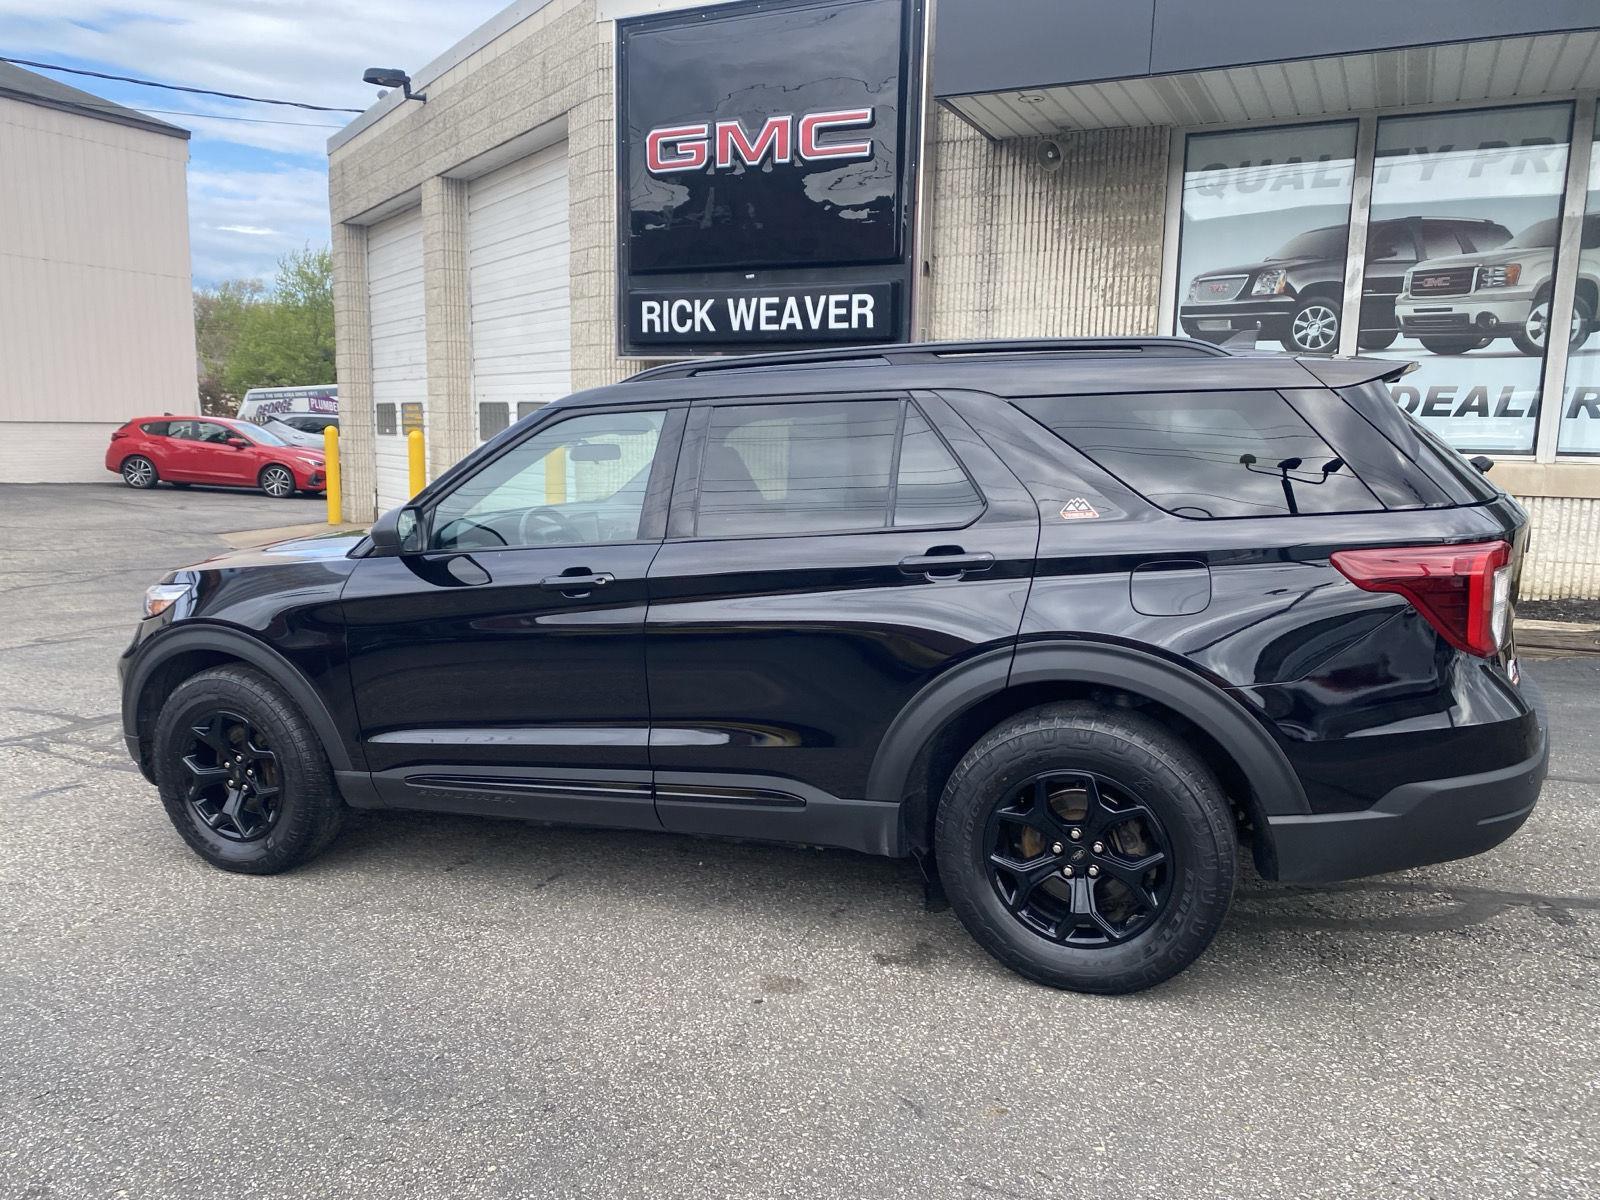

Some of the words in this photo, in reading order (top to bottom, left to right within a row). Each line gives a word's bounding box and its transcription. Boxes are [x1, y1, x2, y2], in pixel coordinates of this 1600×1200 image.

[645, 106, 874, 174] GMC
[1196, 144, 1454, 199] QUALTY
[1423, 275, 1451, 287] GMC
[640, 298, 717, 334] RICK
[727, 292, 875, 332] WEAVER
[256, 398, 293, 417] GEORGE
